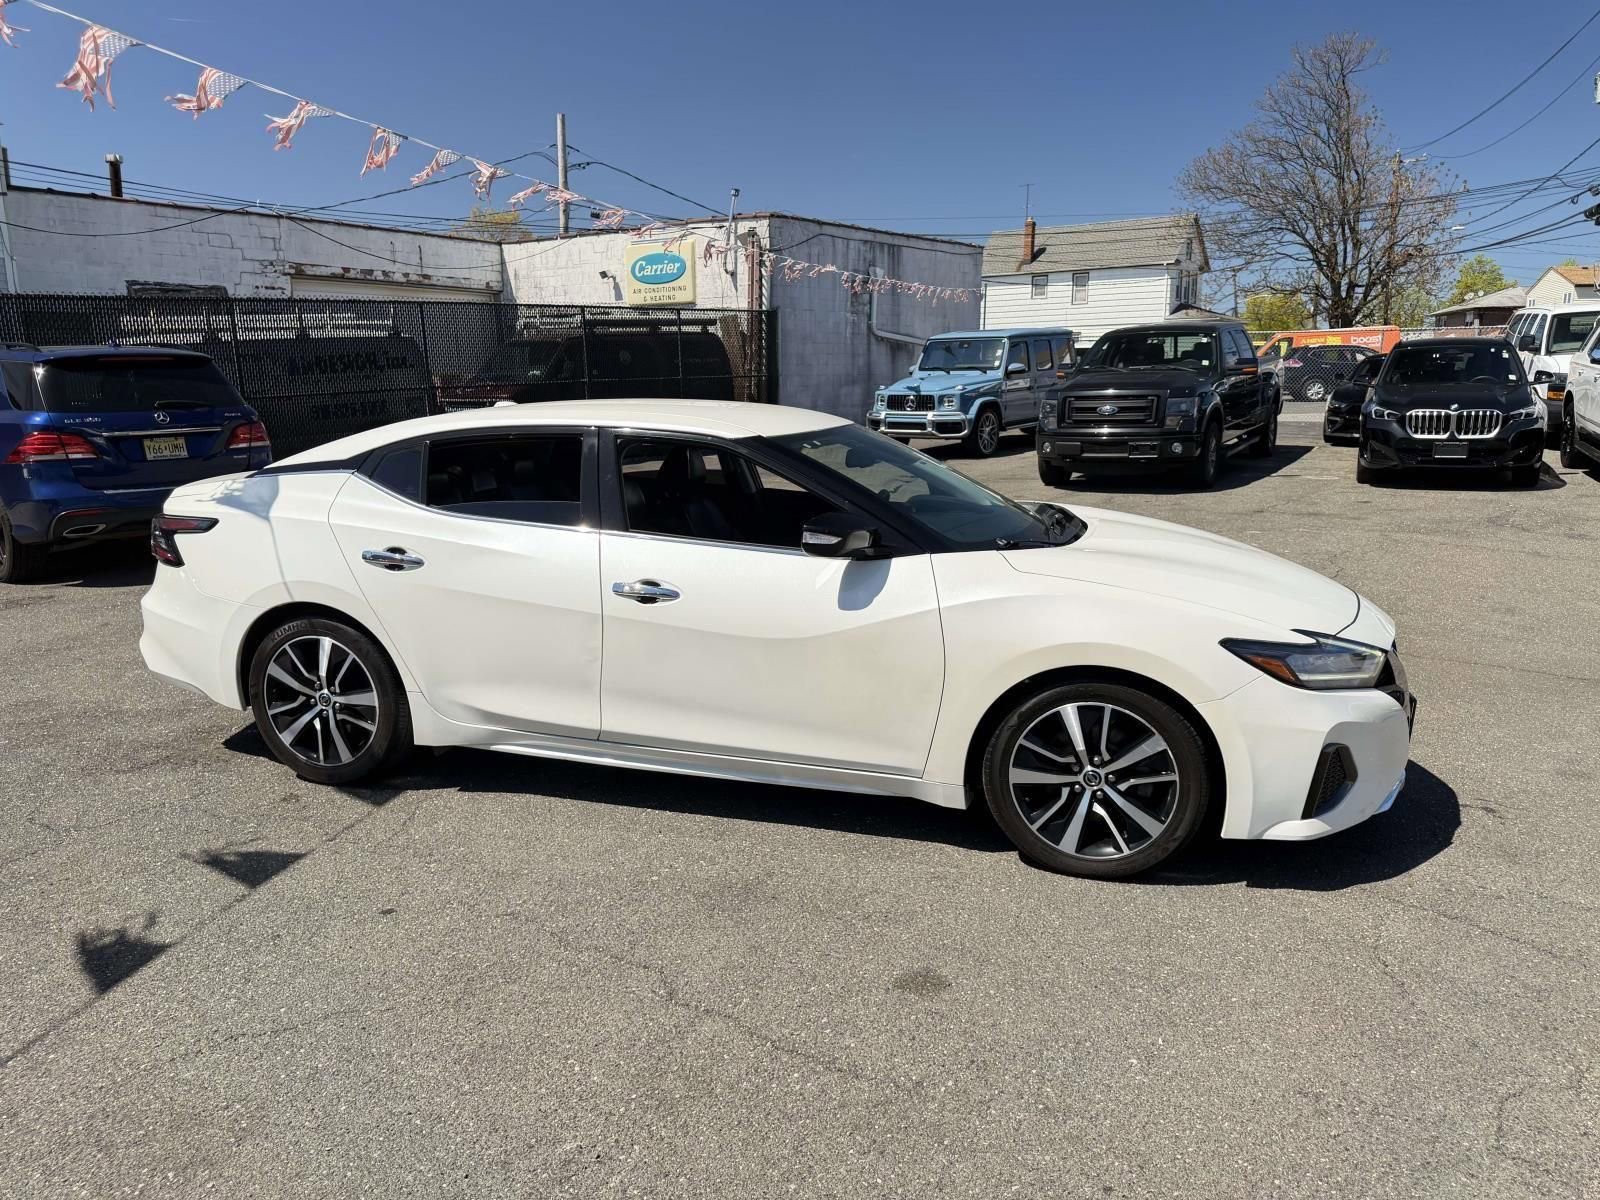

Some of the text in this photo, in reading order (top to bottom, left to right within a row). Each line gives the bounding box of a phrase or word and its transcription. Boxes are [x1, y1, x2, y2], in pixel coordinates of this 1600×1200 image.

[635, 260, 681, 277] Carrier
[644, 285, 687, 294] CONDITIONING
[650, 294, 676, 302] HEATING
